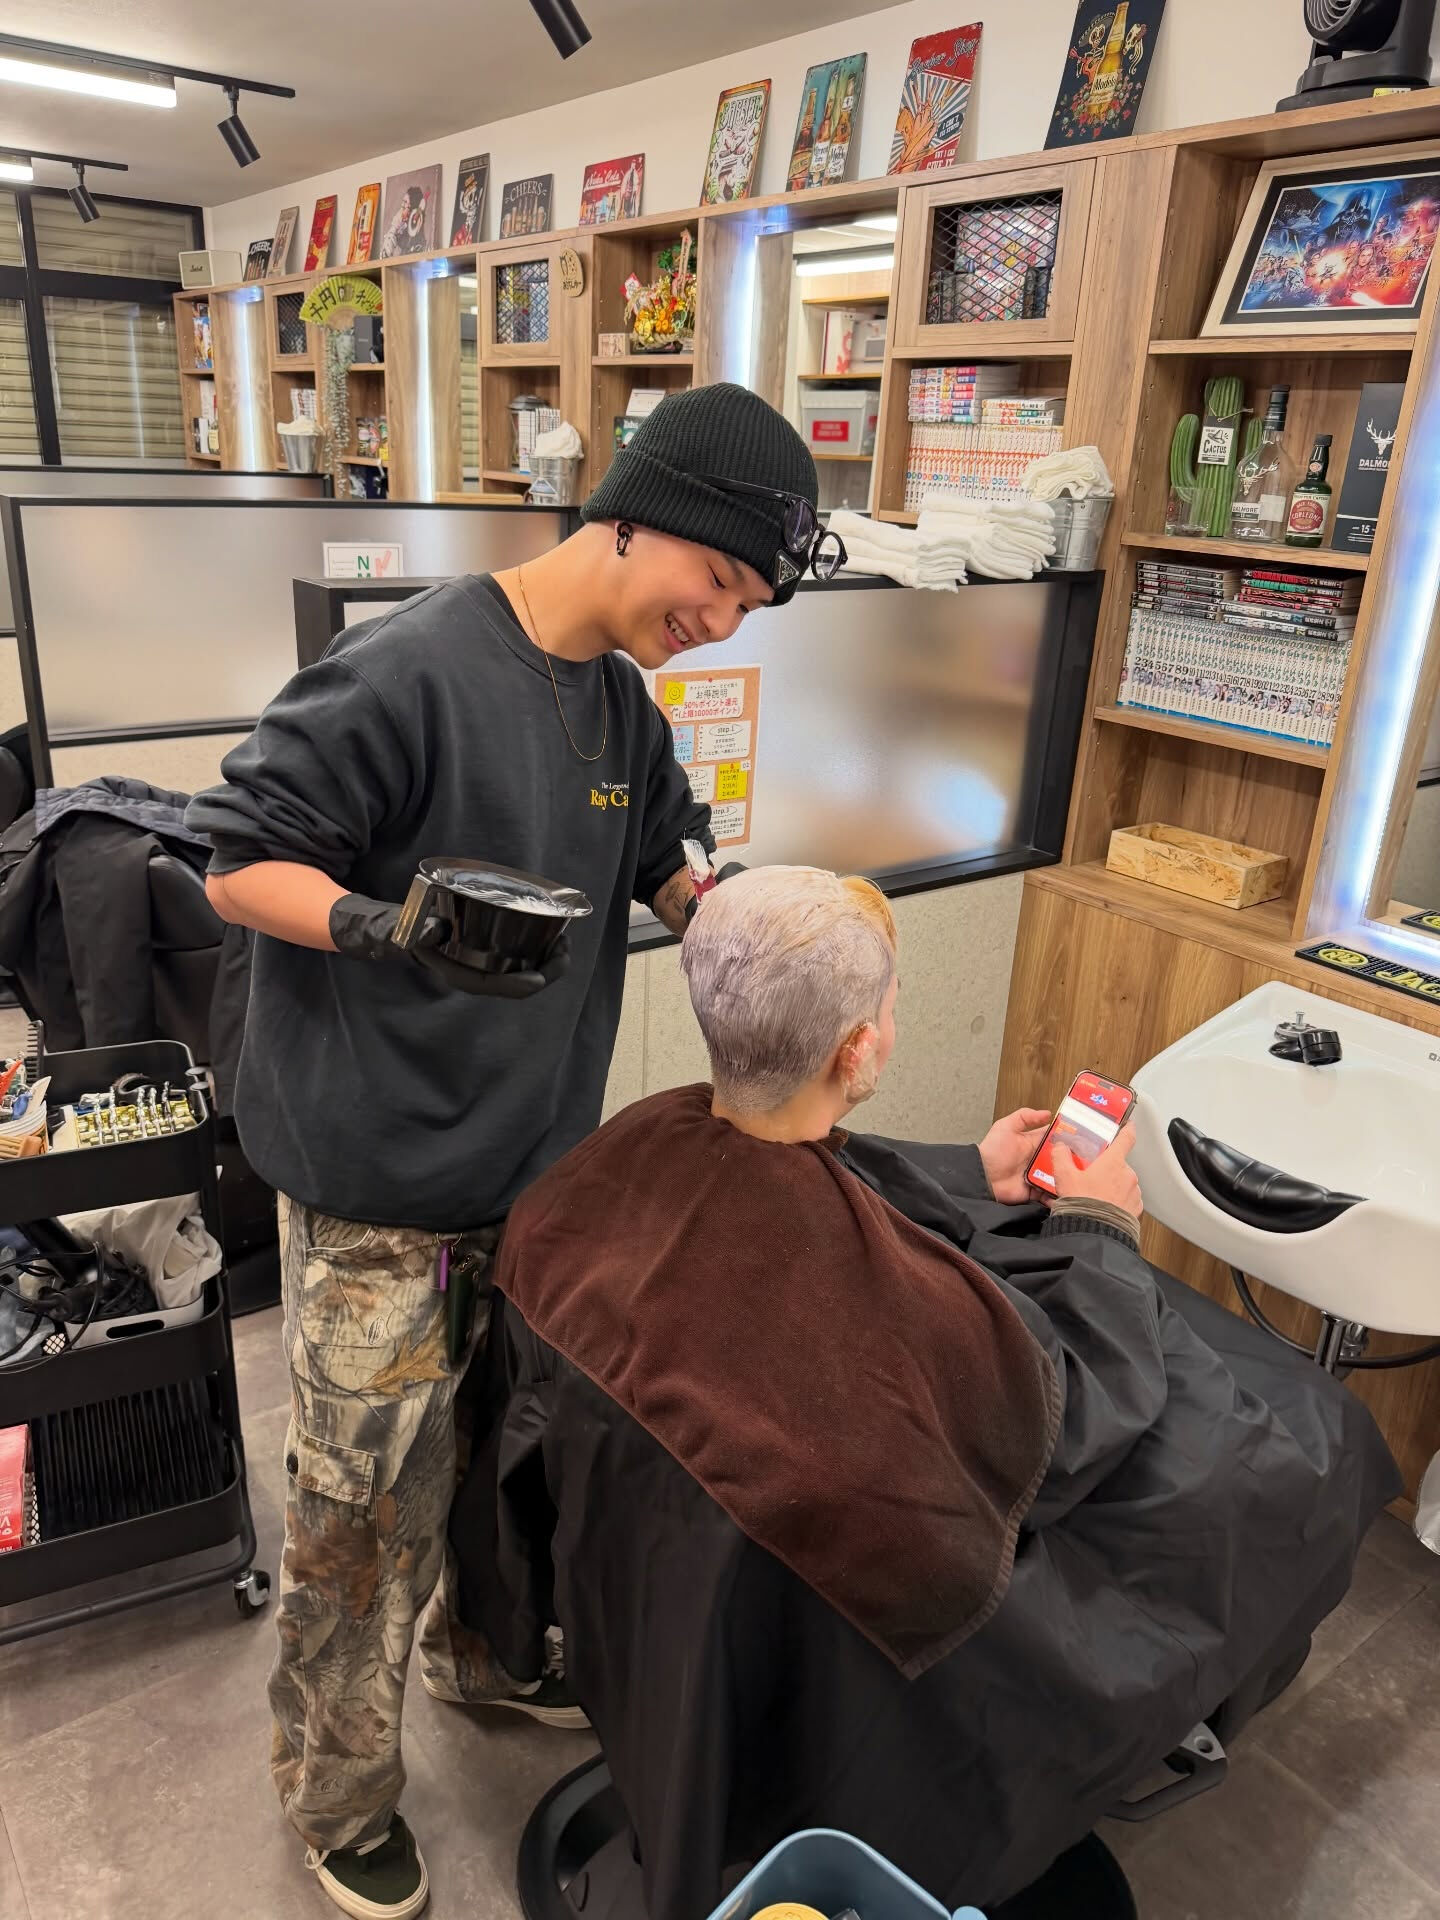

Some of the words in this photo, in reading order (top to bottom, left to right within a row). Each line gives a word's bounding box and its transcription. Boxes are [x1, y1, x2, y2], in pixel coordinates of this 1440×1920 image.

[510, 181, 543, 202] CHEERS
[1360, 524, 1370, 534] 15
[591, 789, 608, 811] Ray
